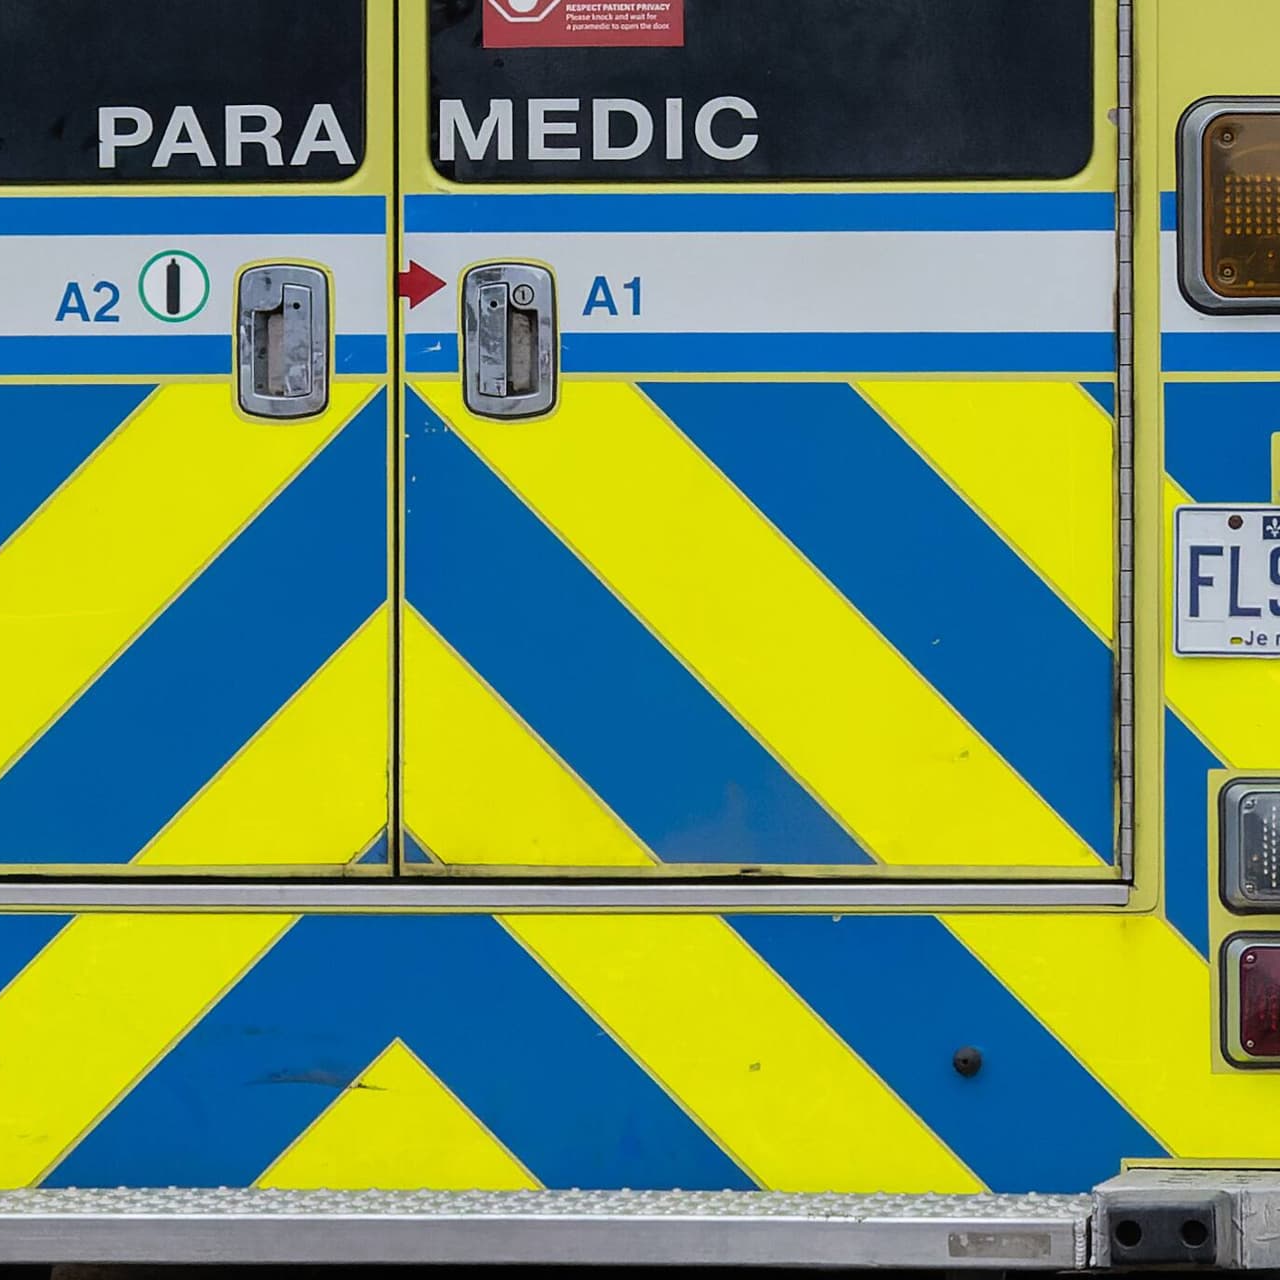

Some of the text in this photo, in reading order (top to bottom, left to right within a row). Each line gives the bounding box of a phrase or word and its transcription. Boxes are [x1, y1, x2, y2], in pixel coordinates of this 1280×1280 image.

[566, 3, 671, 11] RESPECT PATIENT PRIVACY
[96, 96, 760, 169] PARA MEDIC
[55, 280, 120, 322] A2
[582, 275, 644, 317] A1
[1244, 631, 1268, 647] Je
